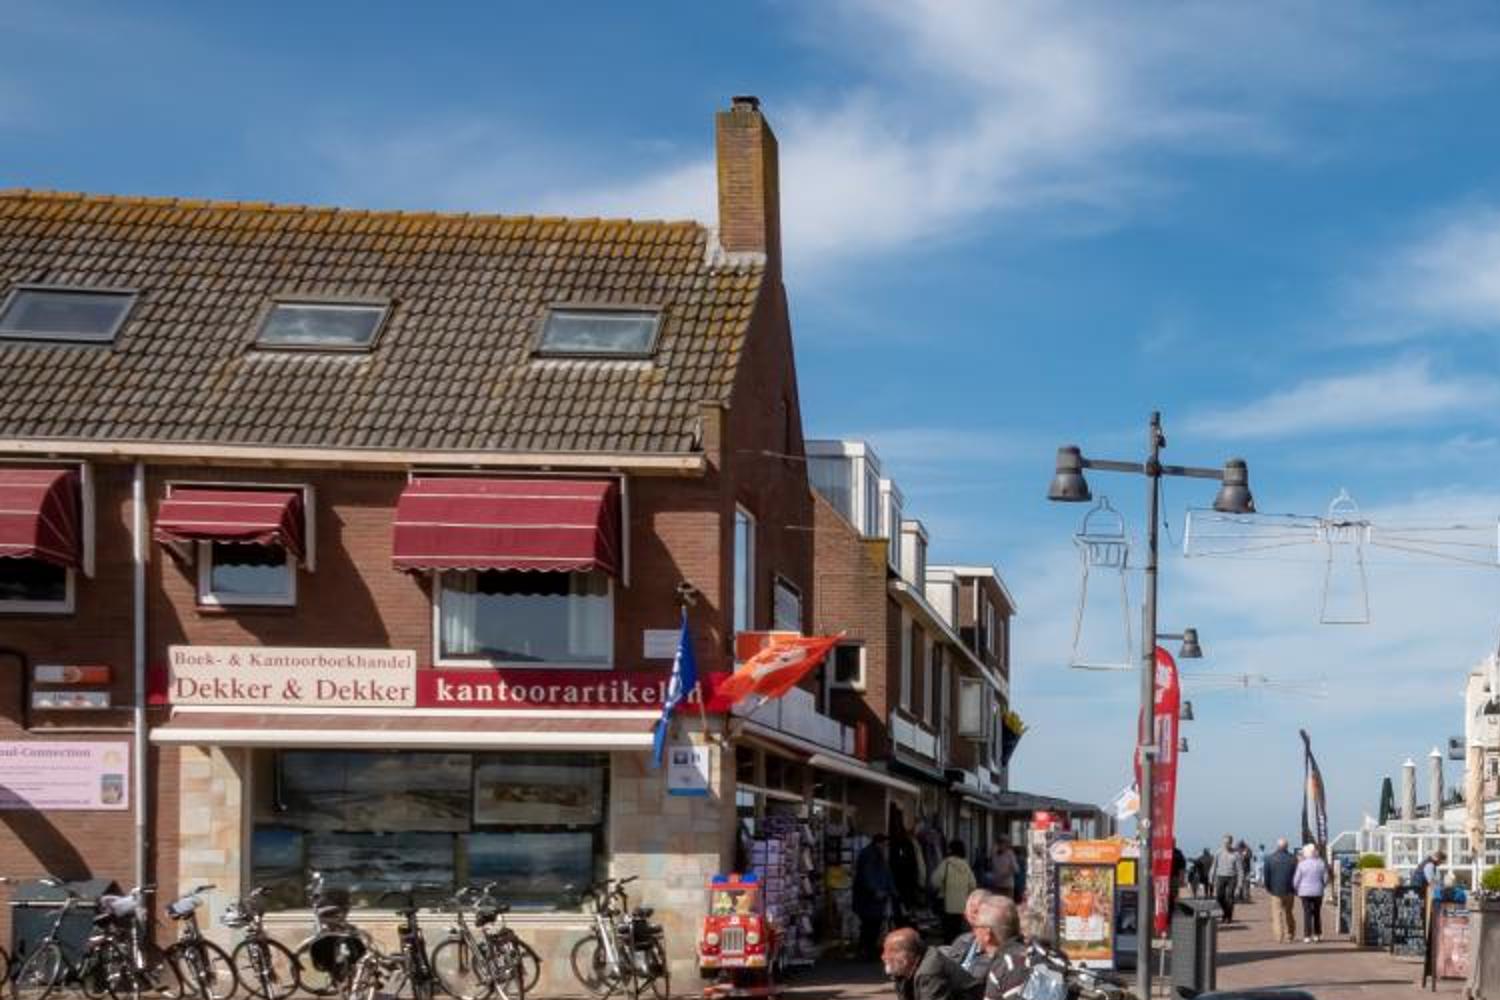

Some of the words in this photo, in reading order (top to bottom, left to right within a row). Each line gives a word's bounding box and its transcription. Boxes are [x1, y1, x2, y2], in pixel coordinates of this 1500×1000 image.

[229, 653, 240, 666] &
[249, 653, 412, 669] Kantoorboekhandel
[175, 677, 272, 699] Dekker
[282, 680, 302, 700] &
[315, 680, 411, 702] Dekker
